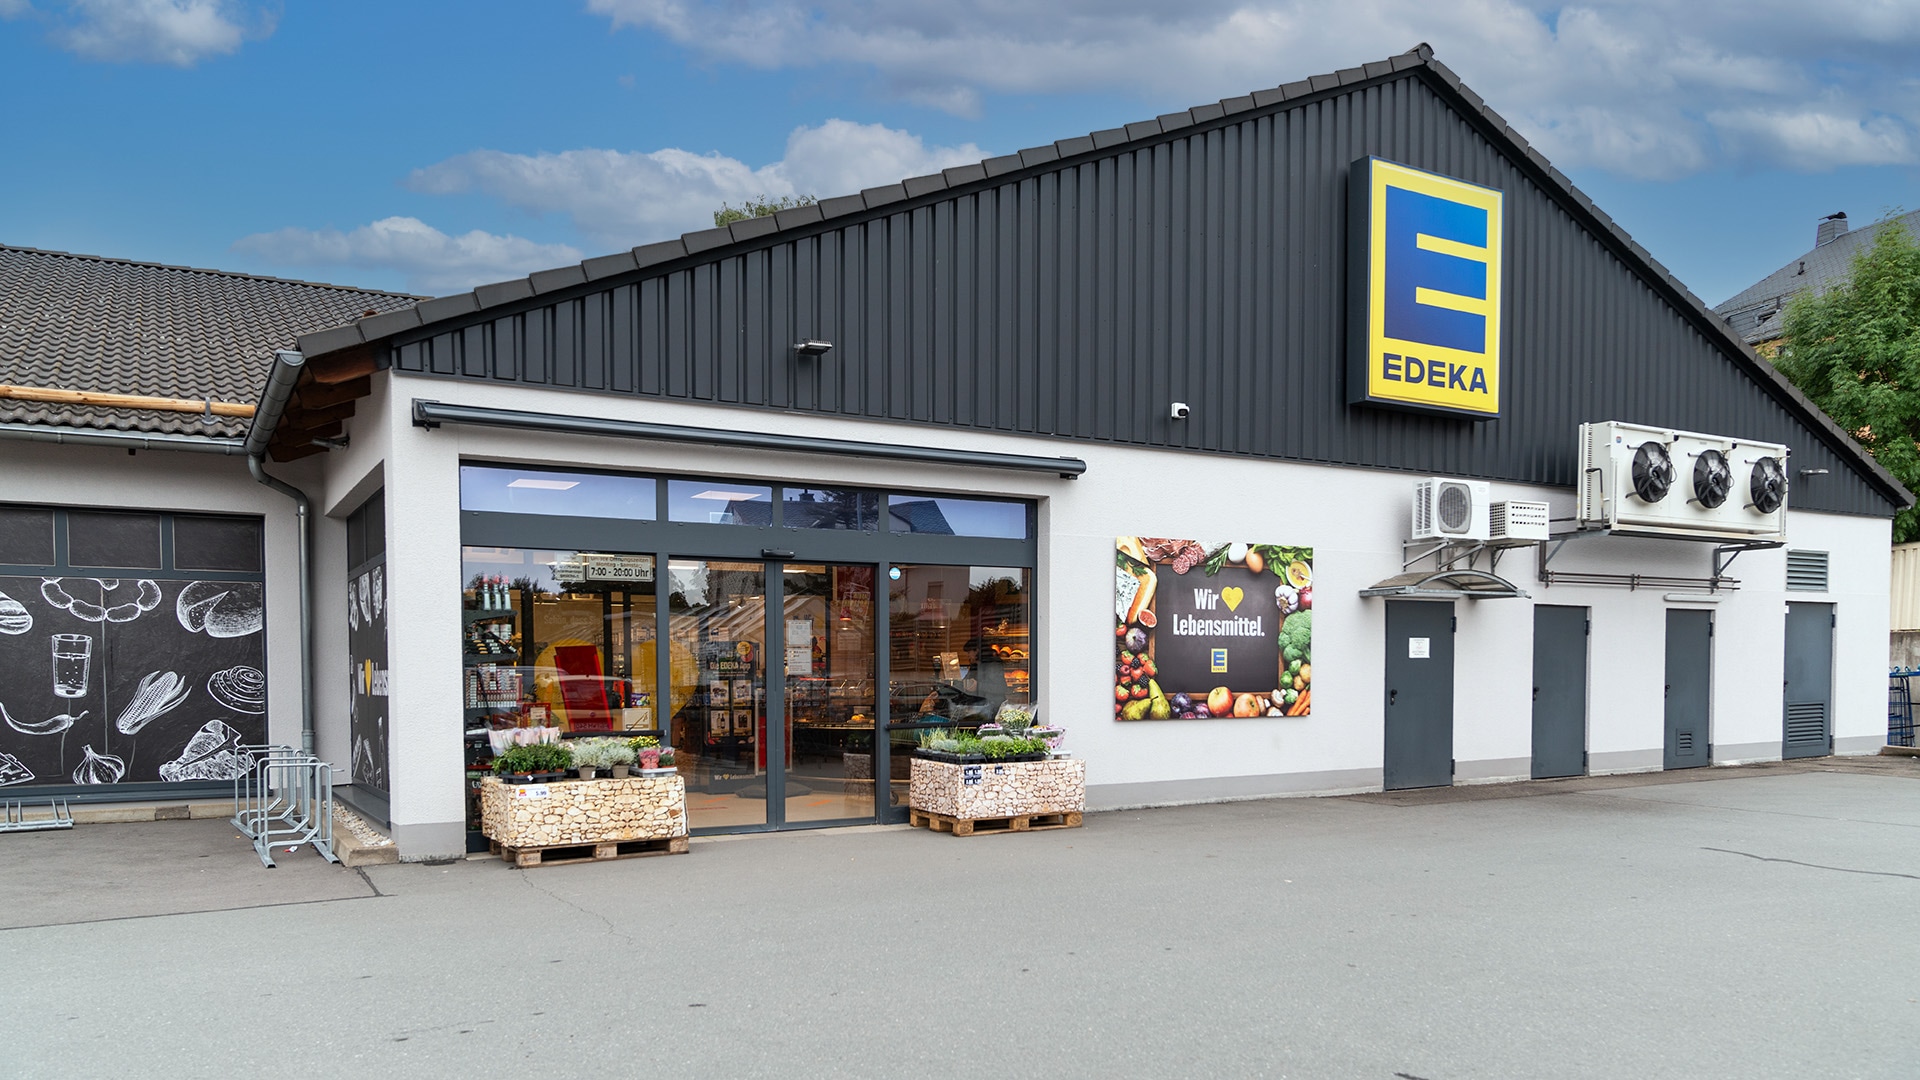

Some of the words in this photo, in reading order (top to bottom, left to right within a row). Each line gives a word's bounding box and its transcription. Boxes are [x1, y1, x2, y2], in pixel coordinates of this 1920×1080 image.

[1384, 184, 1488, 354] E
[1383, 352, 1488, 394] EDEKA
[590, 567, 607, 577] 7:00
[613, 568, 632, 577] 20:00
[634, 568, 649, 577] Uhr
[1194, 588, 1219, 610] Wir
[1173, 614, 1265, 637] Lebensmittel.
